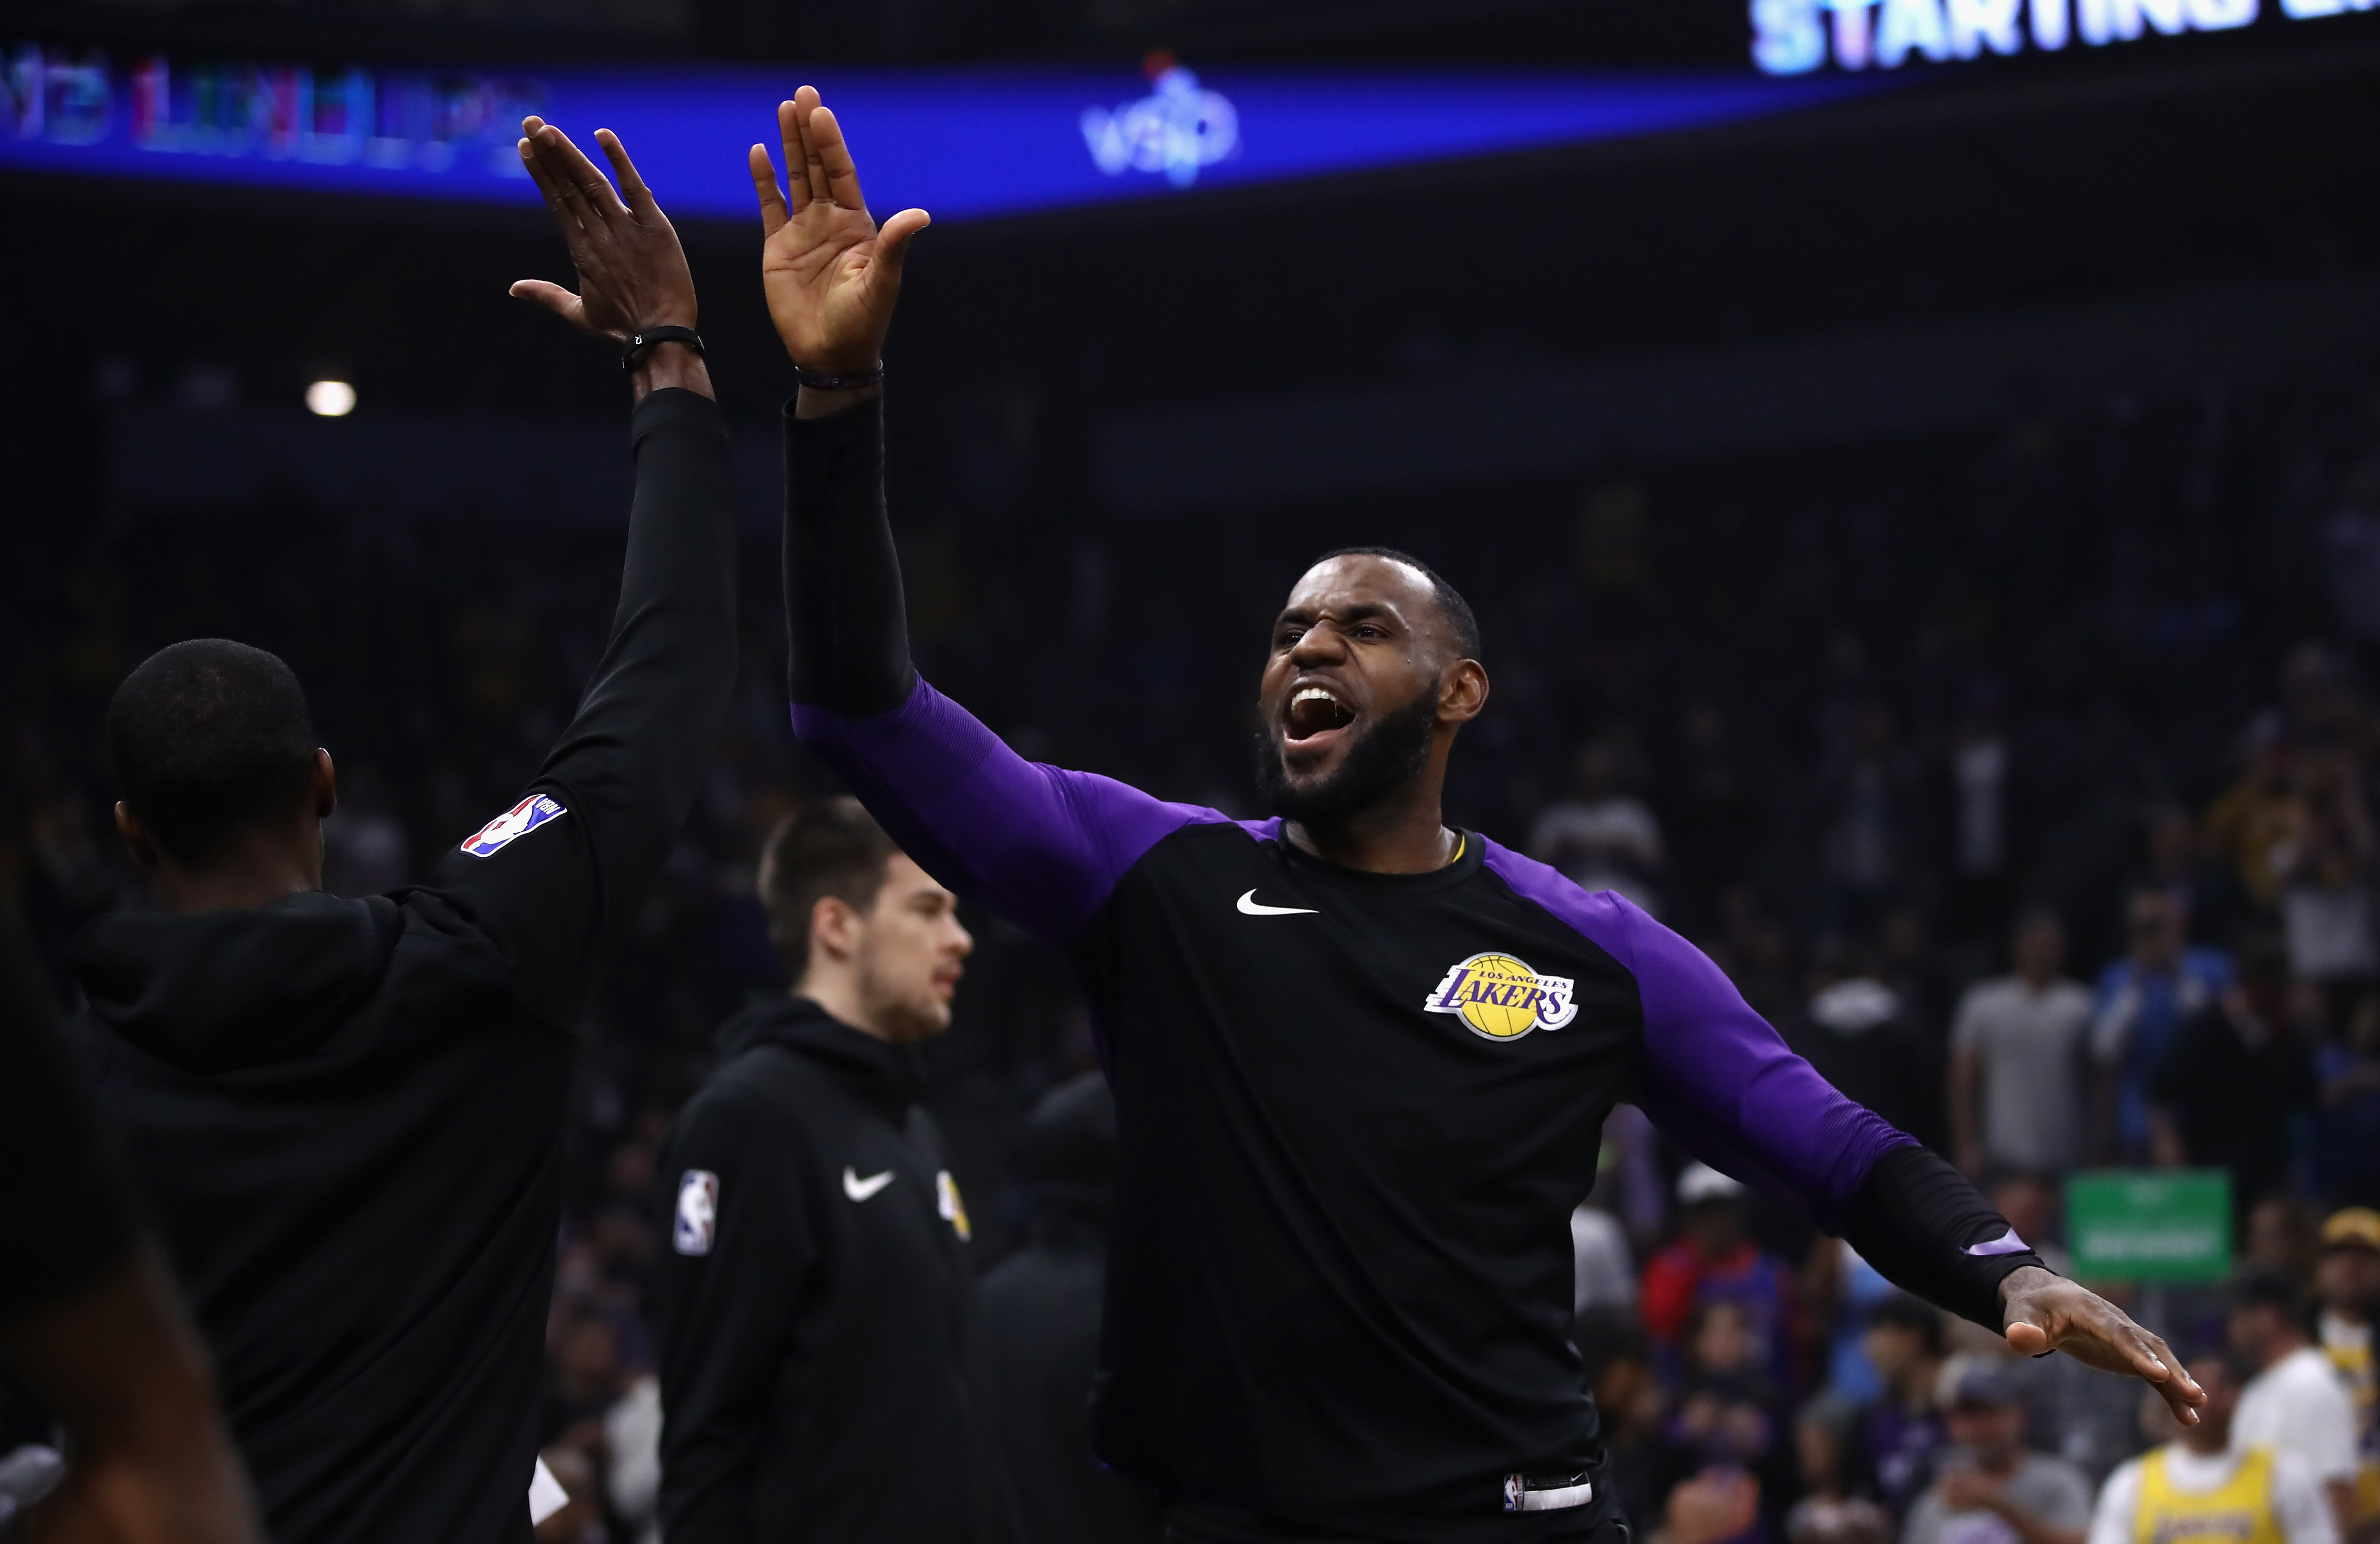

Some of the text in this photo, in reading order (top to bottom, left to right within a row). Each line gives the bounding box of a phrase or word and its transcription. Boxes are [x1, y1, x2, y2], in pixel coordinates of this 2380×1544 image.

[535, 797, 561, 815] NBA
[1479, 971, 1567, 989] LOS ANGELES
[1433, 968, 1572, 1025] LAKERS
